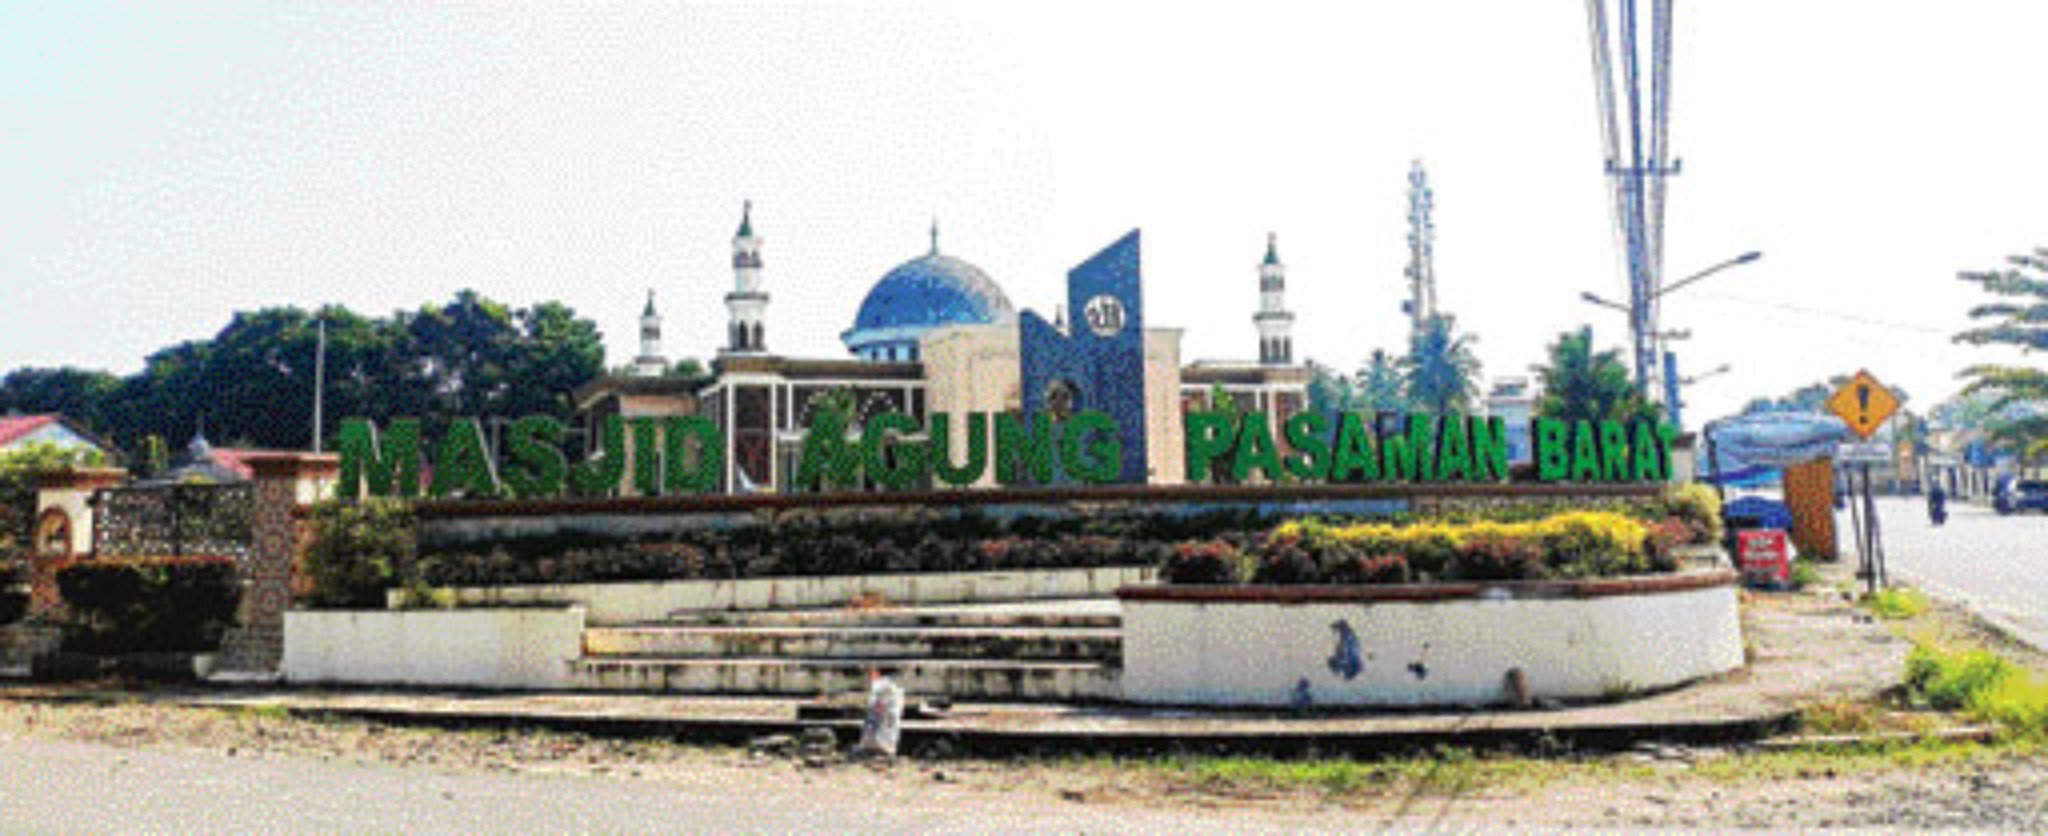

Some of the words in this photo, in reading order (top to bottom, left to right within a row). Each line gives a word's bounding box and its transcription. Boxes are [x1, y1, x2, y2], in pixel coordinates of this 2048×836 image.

[338, 414, 724, 498] MASJID
[800, 410, 1122, 487] AGUNG
[1184, 411, 1509, 483] PASAMAN
[1534, 415, 1676, 482] BARAT
